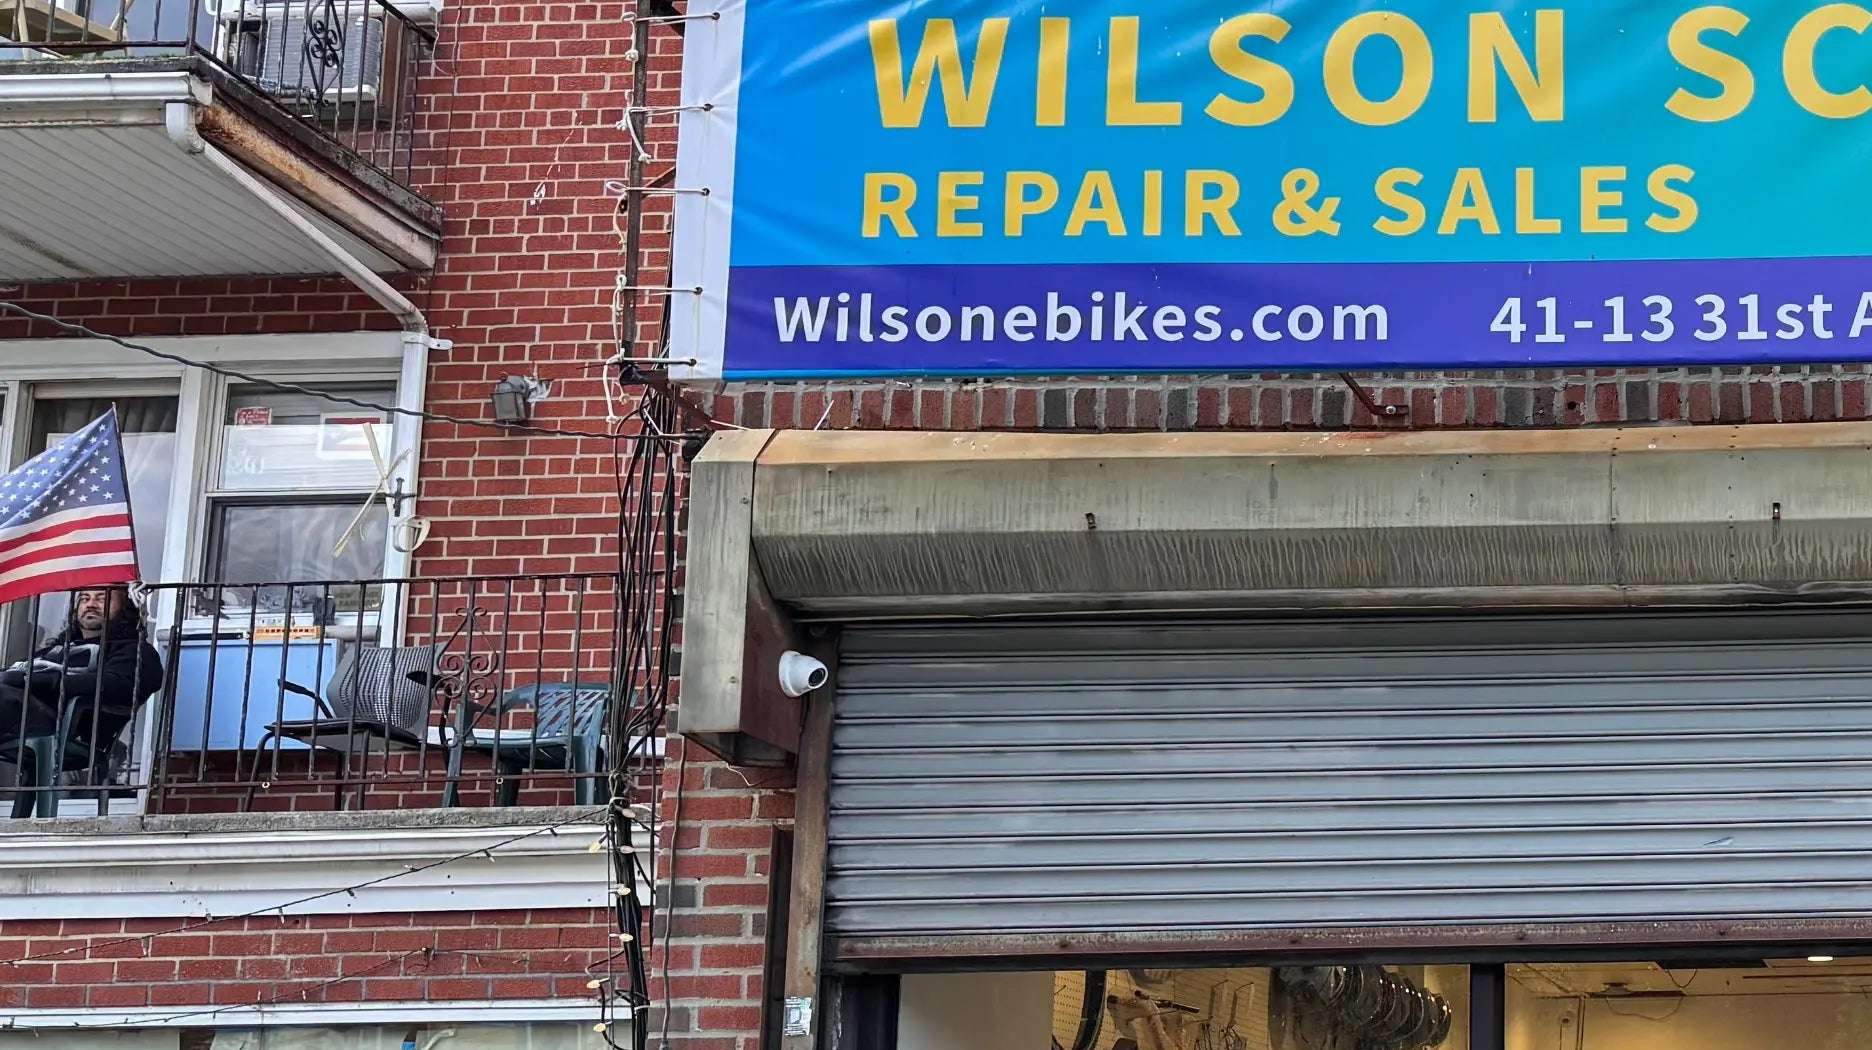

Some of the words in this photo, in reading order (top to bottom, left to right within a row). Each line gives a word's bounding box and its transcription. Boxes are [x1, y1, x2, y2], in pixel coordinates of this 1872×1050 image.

[870, 10, 1564, 128] WILSON
[863, 171, 1242, 238] REPAIR
[1273, 168, 1341, 236] &
[1374, 164, 1698, 236] SALES
[773, 290, 1389, 344] Wilsonebikes.com
[1490, 295, 1675, 343] 41-13
[1693, 291, 1834, 341] 31st
